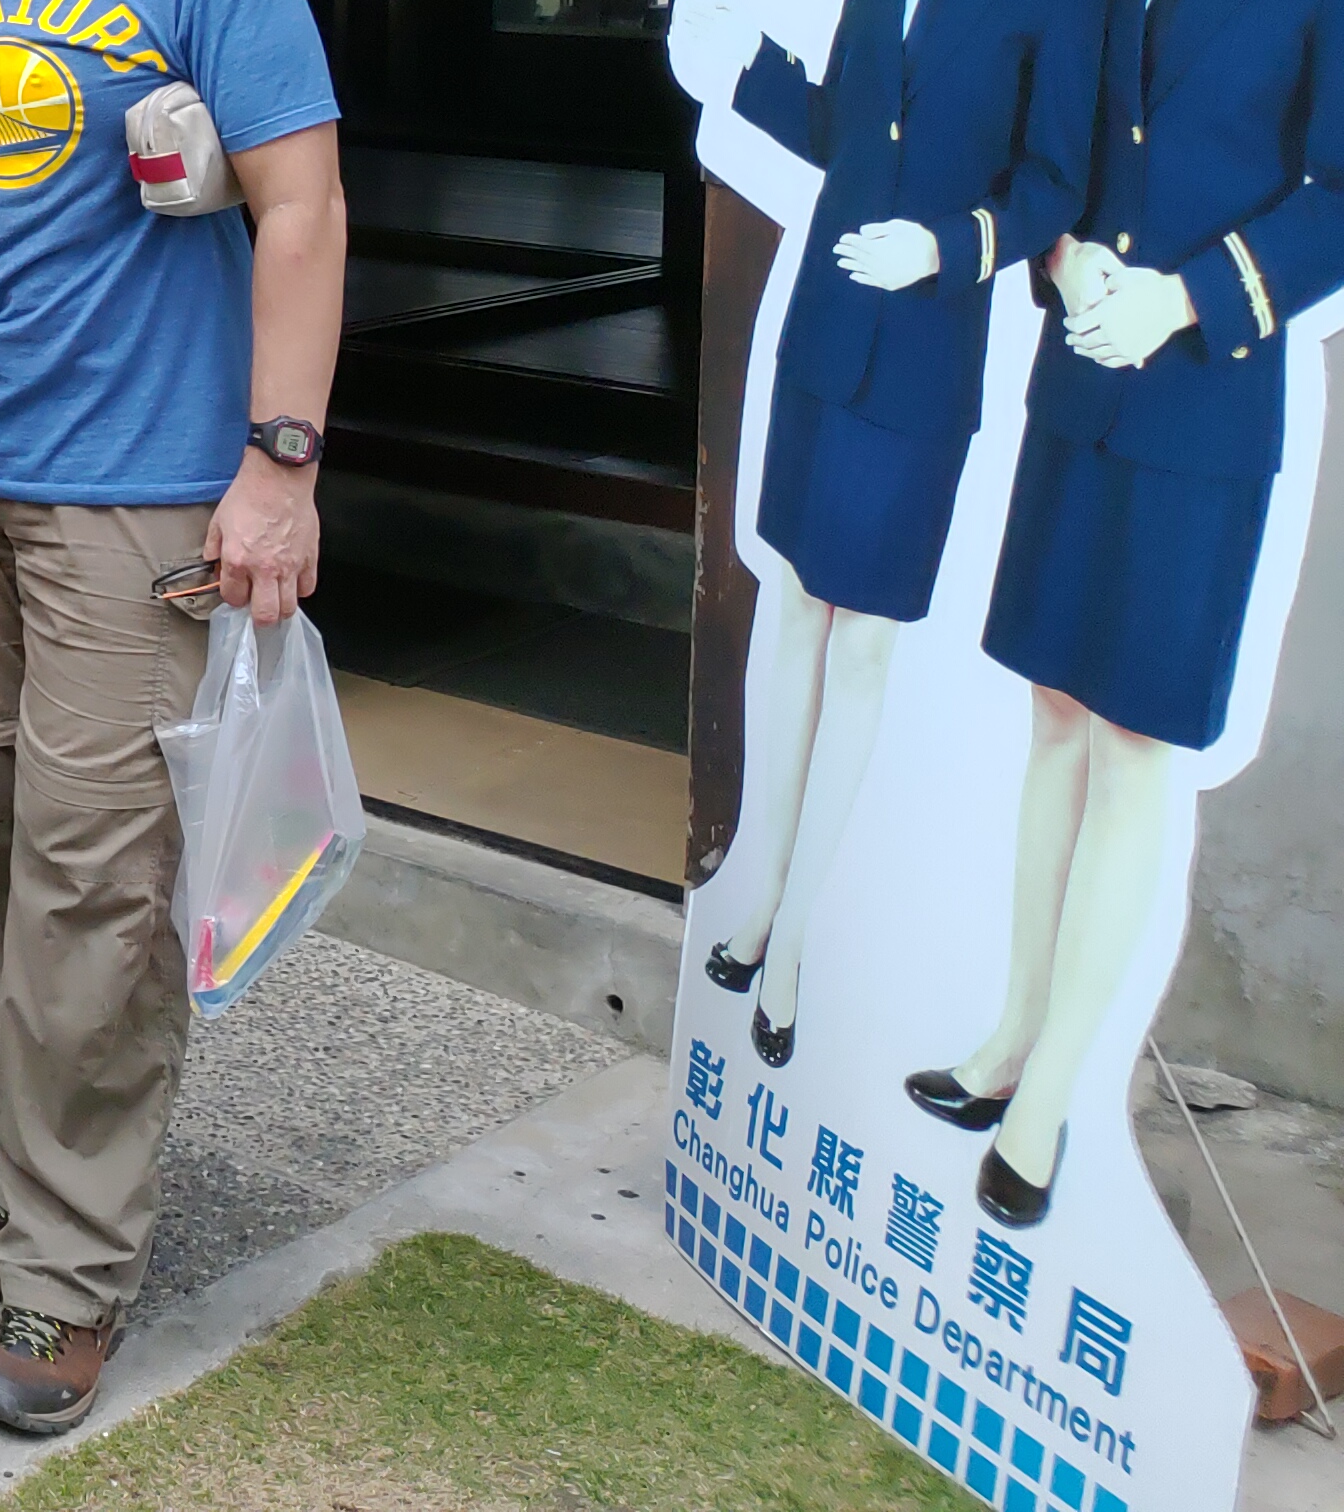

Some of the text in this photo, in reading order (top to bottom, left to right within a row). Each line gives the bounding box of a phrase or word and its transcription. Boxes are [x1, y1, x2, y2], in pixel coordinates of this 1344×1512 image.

[673, 1108, 1137, 1476] Changhua Police Department
[685, 1037, 1134, 1397] 彰化縣警察局
